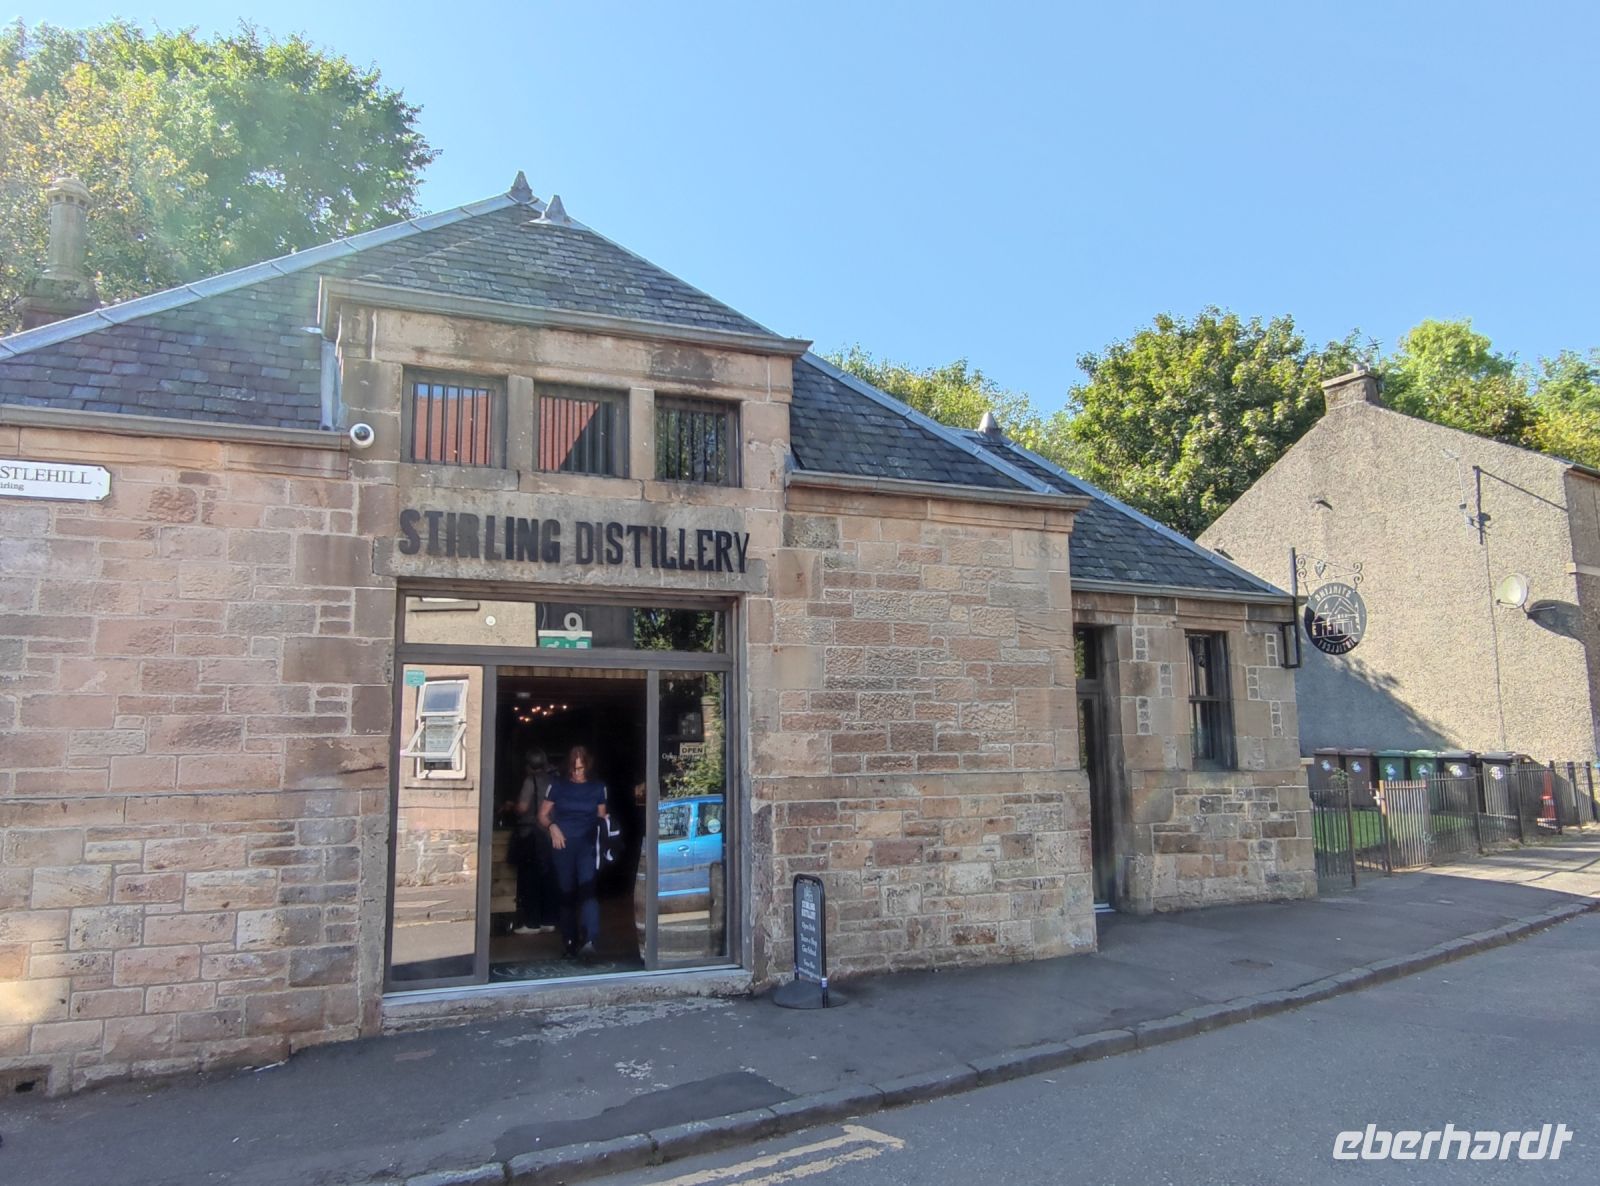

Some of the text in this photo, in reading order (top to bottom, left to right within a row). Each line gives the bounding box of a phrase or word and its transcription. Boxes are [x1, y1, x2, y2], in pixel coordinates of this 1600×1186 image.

[398, 508, 750, 573] STIRLING DISTILLERY
[564, 612, 583, 641] 9
